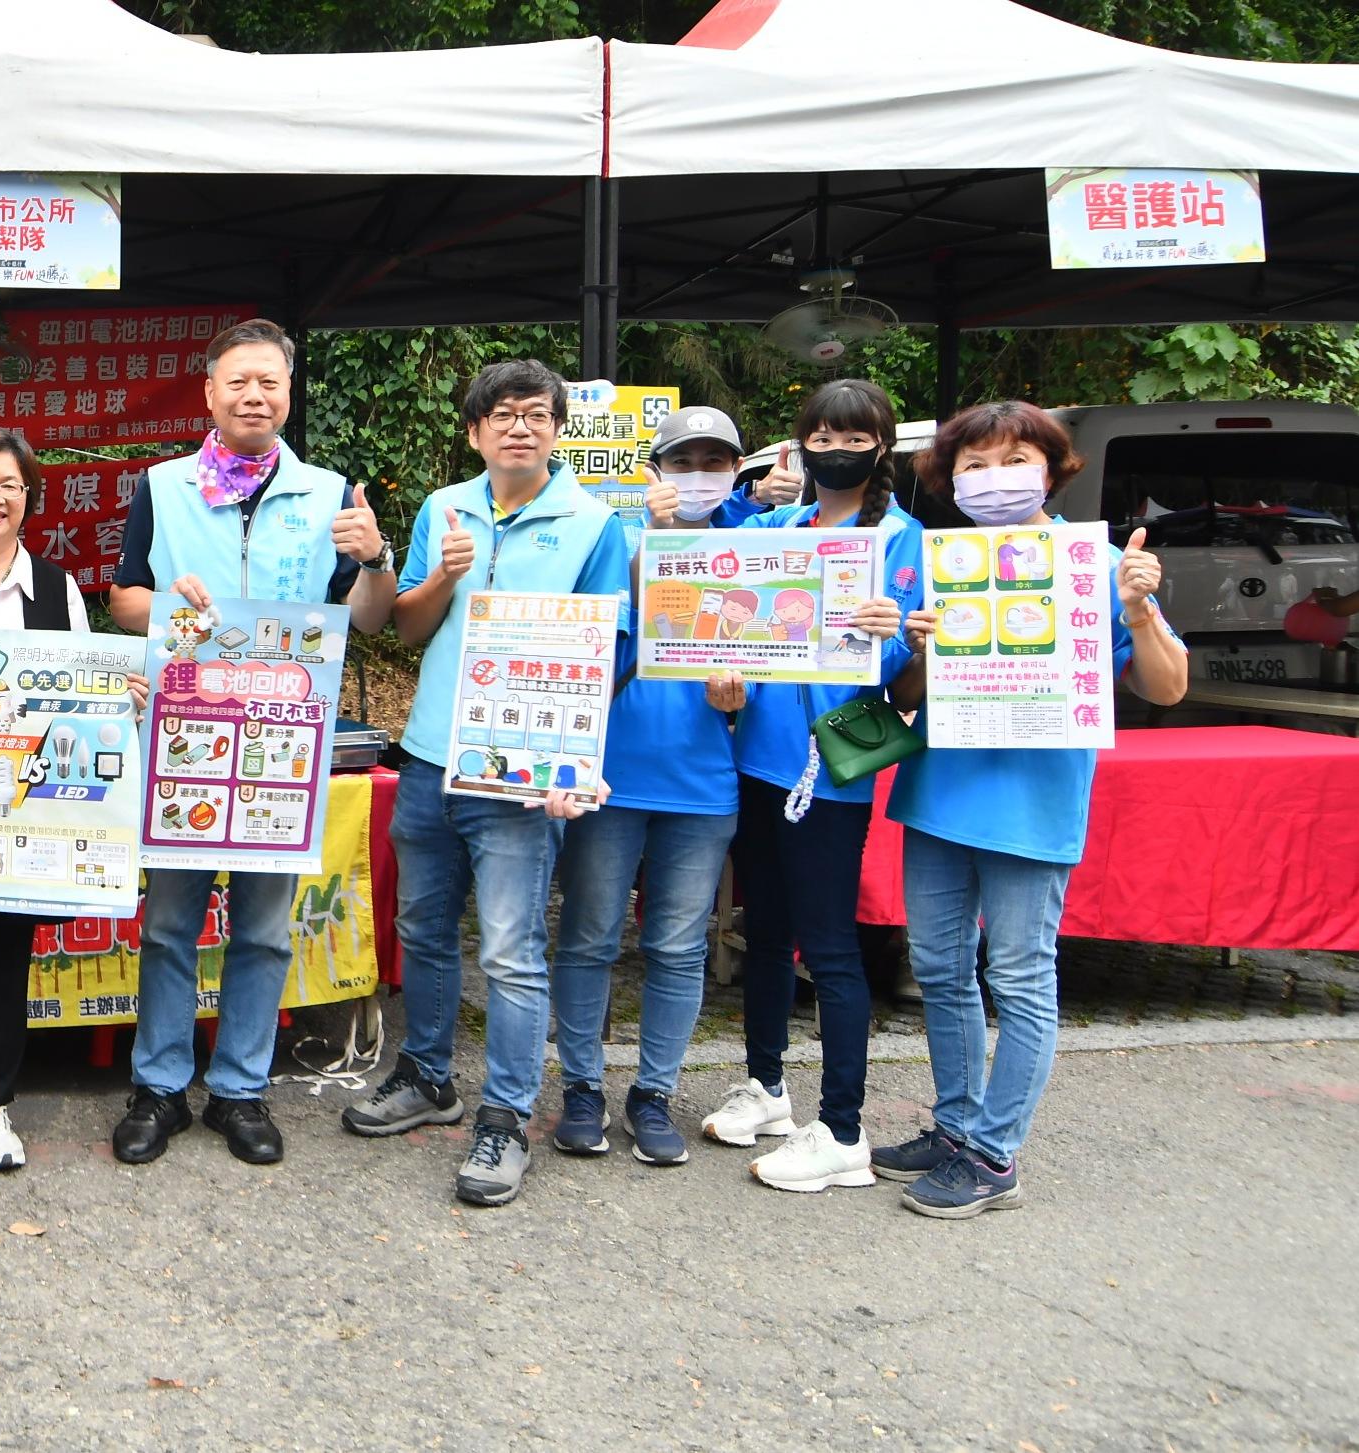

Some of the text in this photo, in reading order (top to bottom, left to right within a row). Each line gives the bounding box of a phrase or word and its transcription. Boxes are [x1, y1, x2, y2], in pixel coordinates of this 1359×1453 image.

[1084, 179, 1225, 230] 醫護站
[559, 413, 635, 439] 圾減量
[1068, 541, 1101, 728] 優質如廁禮儀
[13, 647, 131, 668] 照明光源汰換回收
[19, 669, 128, 695] 優先選 LED
[164, 663, 303, 697] 鋰電池回收
[509, 660, 603, 682] 預防登革熱
[248, 700, 322, 720] 不可不理
[537, 711, 555, 728] 清
[19, 755, 51, 786] VS
[55, 786, 89, 799] LED
